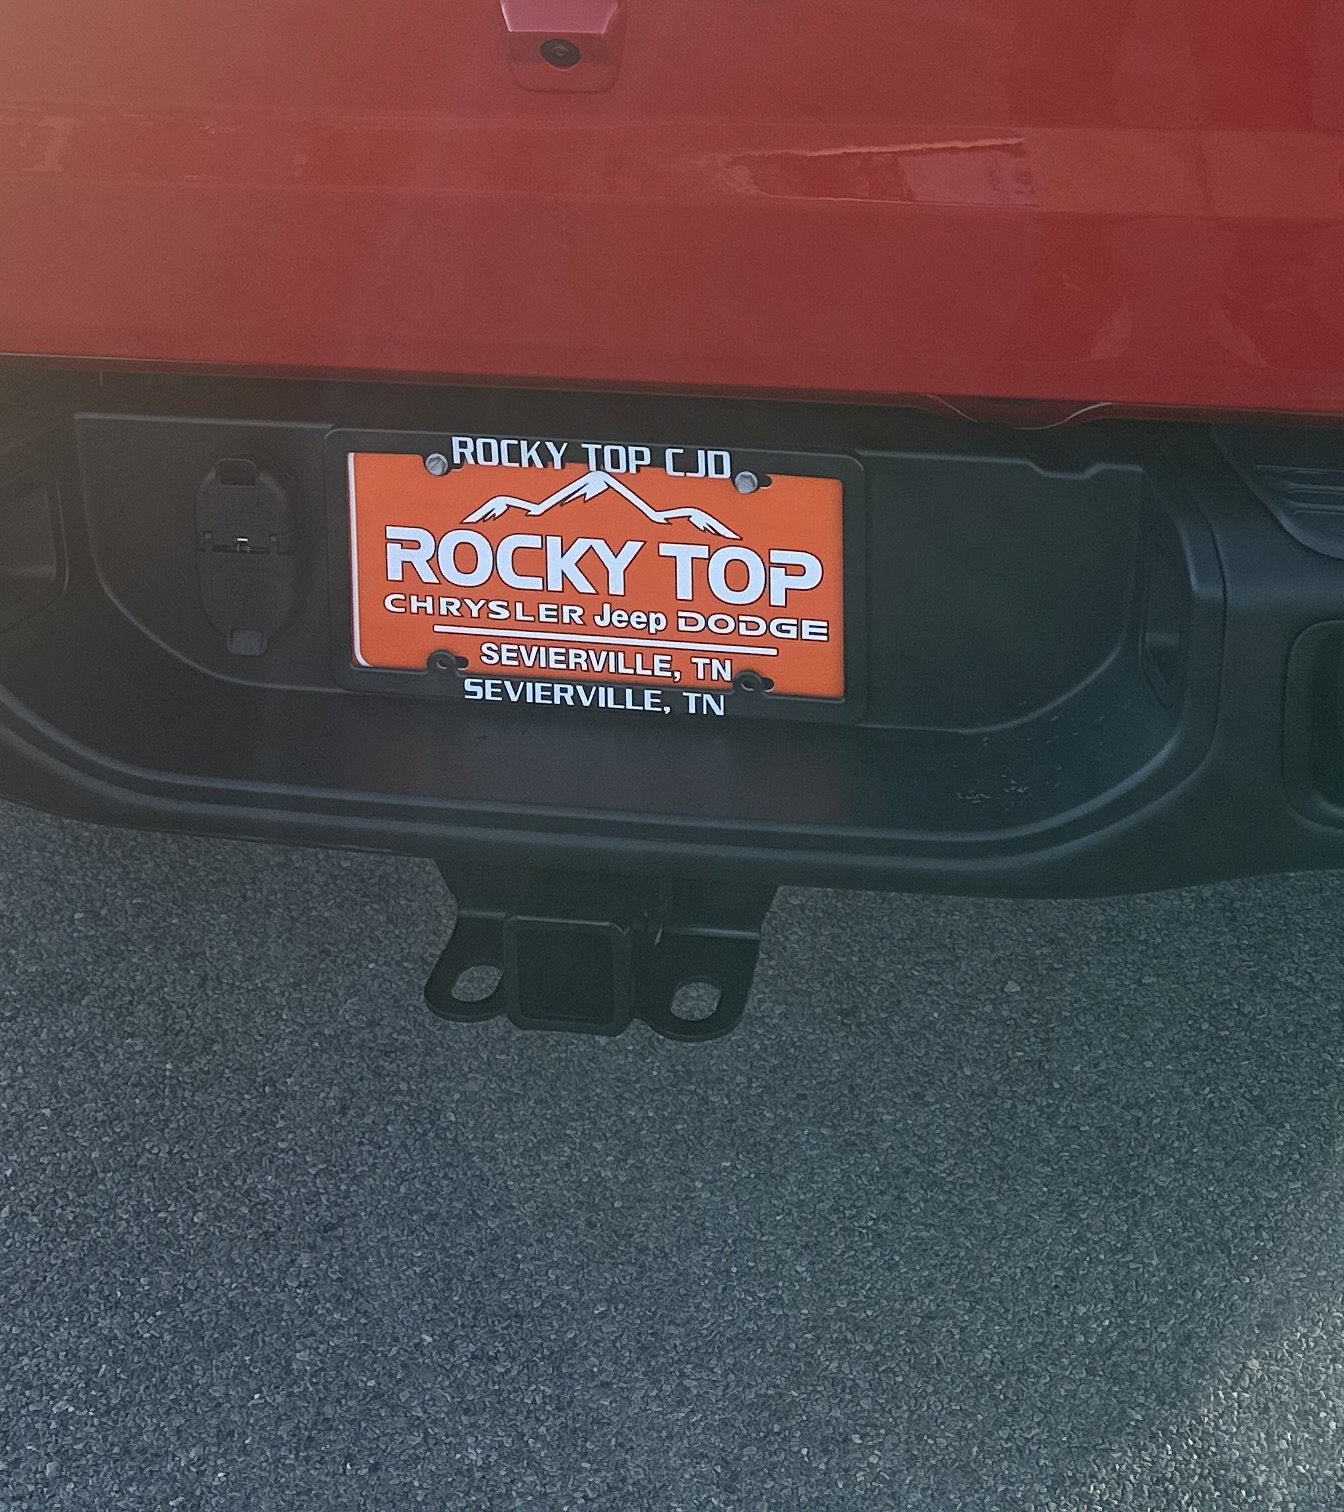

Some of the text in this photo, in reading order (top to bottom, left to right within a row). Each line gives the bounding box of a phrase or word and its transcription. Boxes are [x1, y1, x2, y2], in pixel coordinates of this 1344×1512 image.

[452, 436, 732, 480] ROCKY TOP CJD
[384, 525, 824, 607] ROCKY TOP
[383, 593, 829, 642] CHRYSLER Jeep DODGE
[479, 642, 732, 683] SEVIERVILLE, TN
[464, 678, 725, 717] SEVIERVILLE, TN
